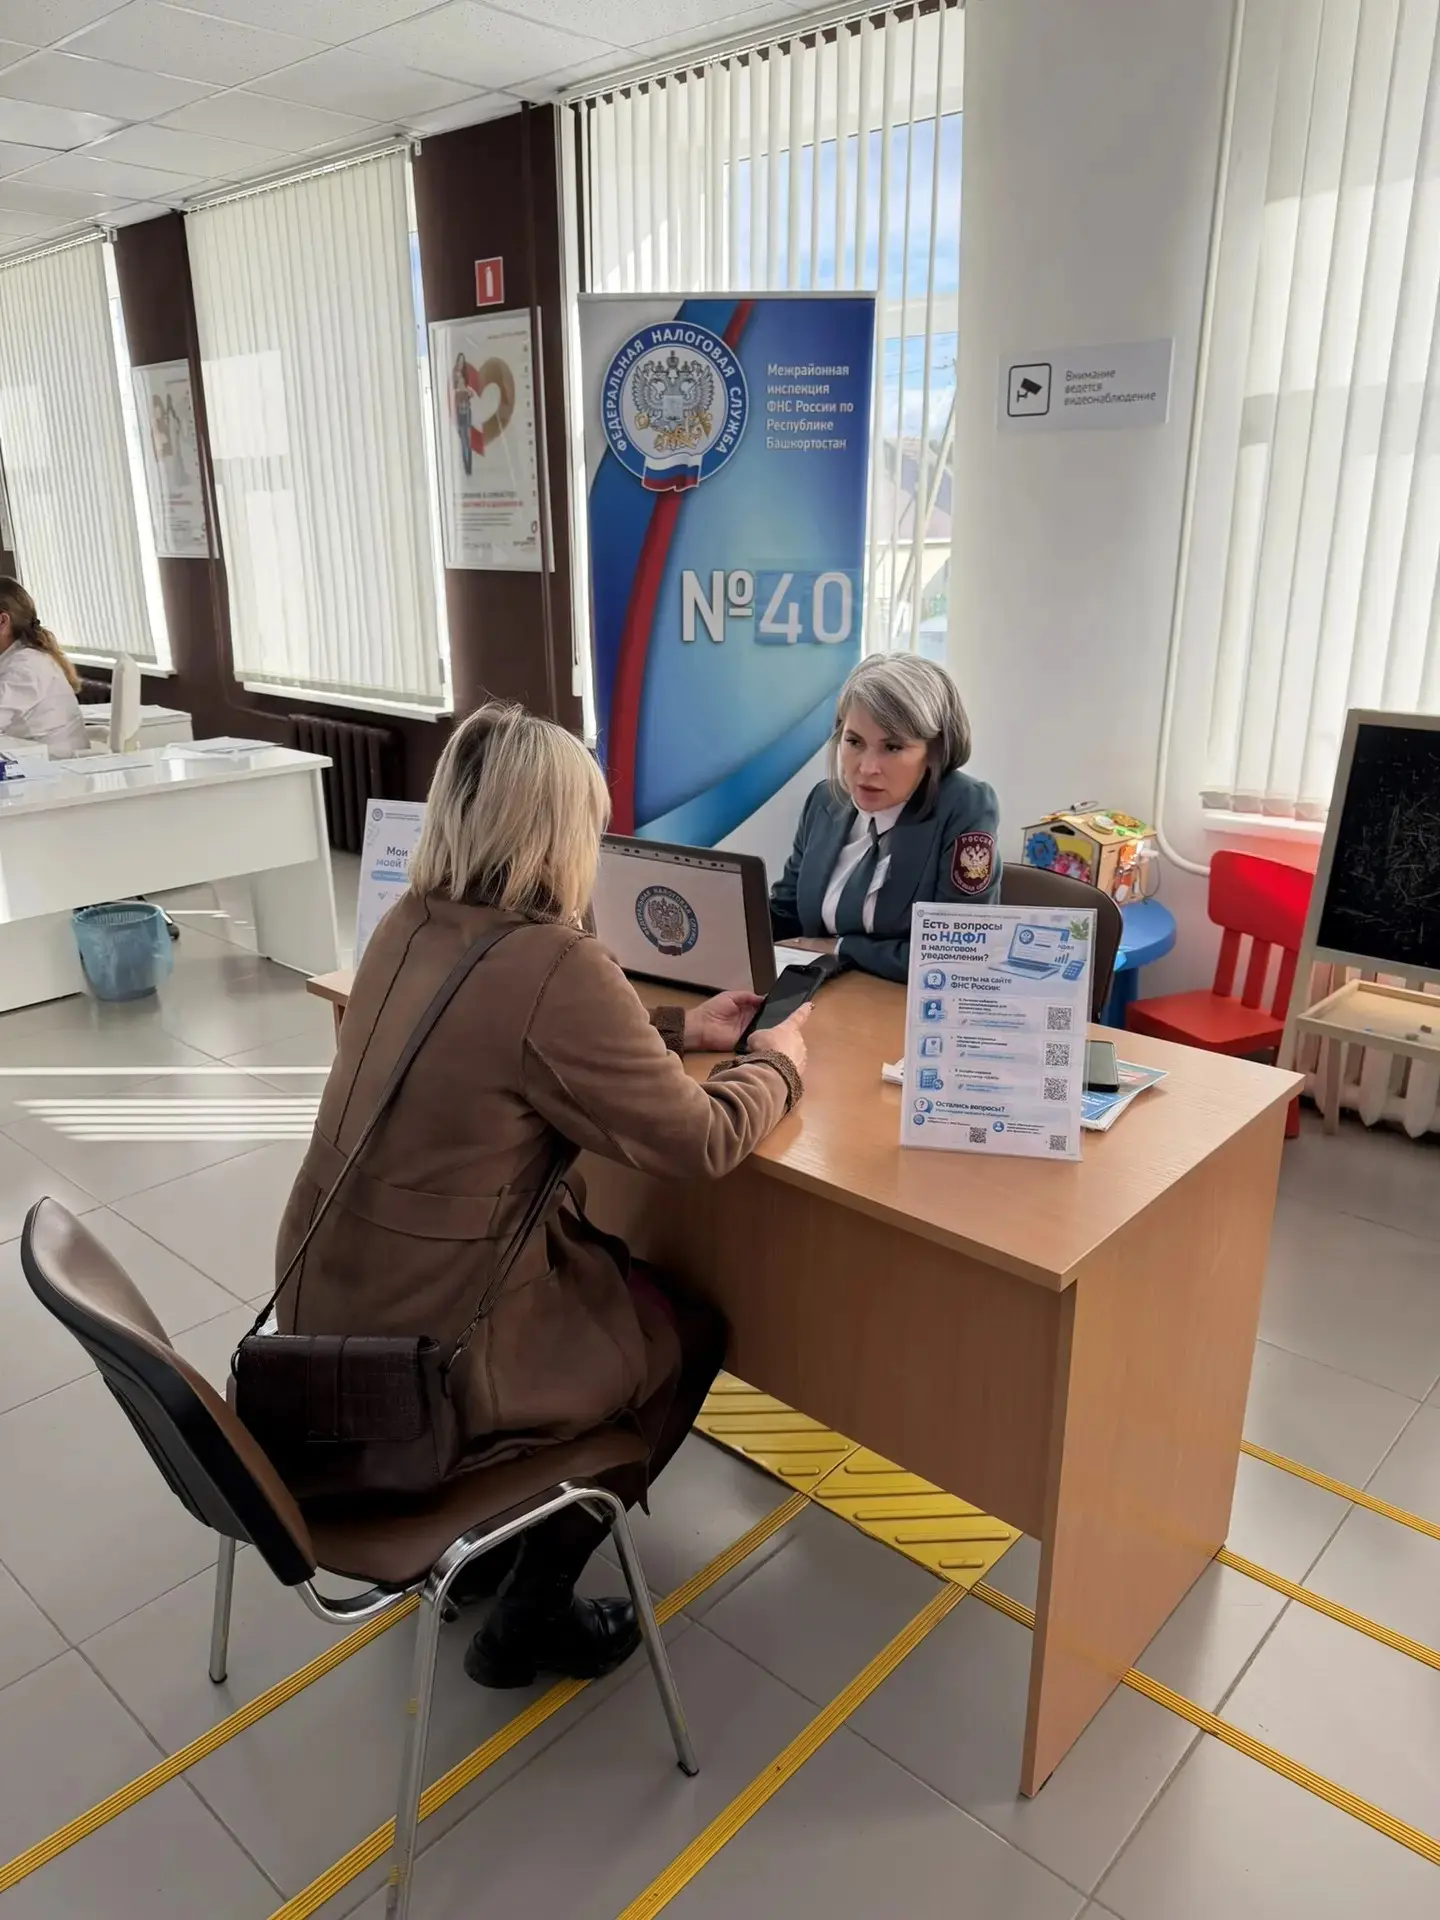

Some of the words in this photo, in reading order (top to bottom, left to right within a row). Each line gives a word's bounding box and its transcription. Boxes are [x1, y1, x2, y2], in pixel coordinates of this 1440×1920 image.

[767, 363, 850, 377] Межрайонная
[1065, 369, 1116, 382] Внимание
[606, 339, 645, 451] ФЕДЕРАЛЬНАЯ
[651, 328, 736, 378] НАЛОГОВАЯ
[715, 386, 742, 454] СЛУЖБА
[767, 383, 830, 396] инспекция
[1064, 383, 1103, 394] ведется
[1064, 392, 1156, 406] видеонаблюдение
[766, 400, 793, 413] ФНС
[795, 400, 837, 413] России
[839, 402, 854, 413] по
[766, 418, 834, 434] Республике
[766, 436, 847, 452] Башкортостан
[386, 846, 408, 857] Мои
[376, 858, 402, 868] моей
[922, 919, 950, 929] Есть
[953, 922, 1003, 932] вопросы
[921, 934, 938, 942] по
[939, 931, 987, 944] НДФЛ
[928, 944, 977, 953] налоговом
[920, 952, 989, 962] уведомлении?
[950, 974, 980, 983] Ответы
[950, 981, 970, 989] ФНС
[971, 983, 1001, 991] России:
[935, 1100, 969, 1109] Остались
[970, 1104, 1006, 1112] вопросы?
